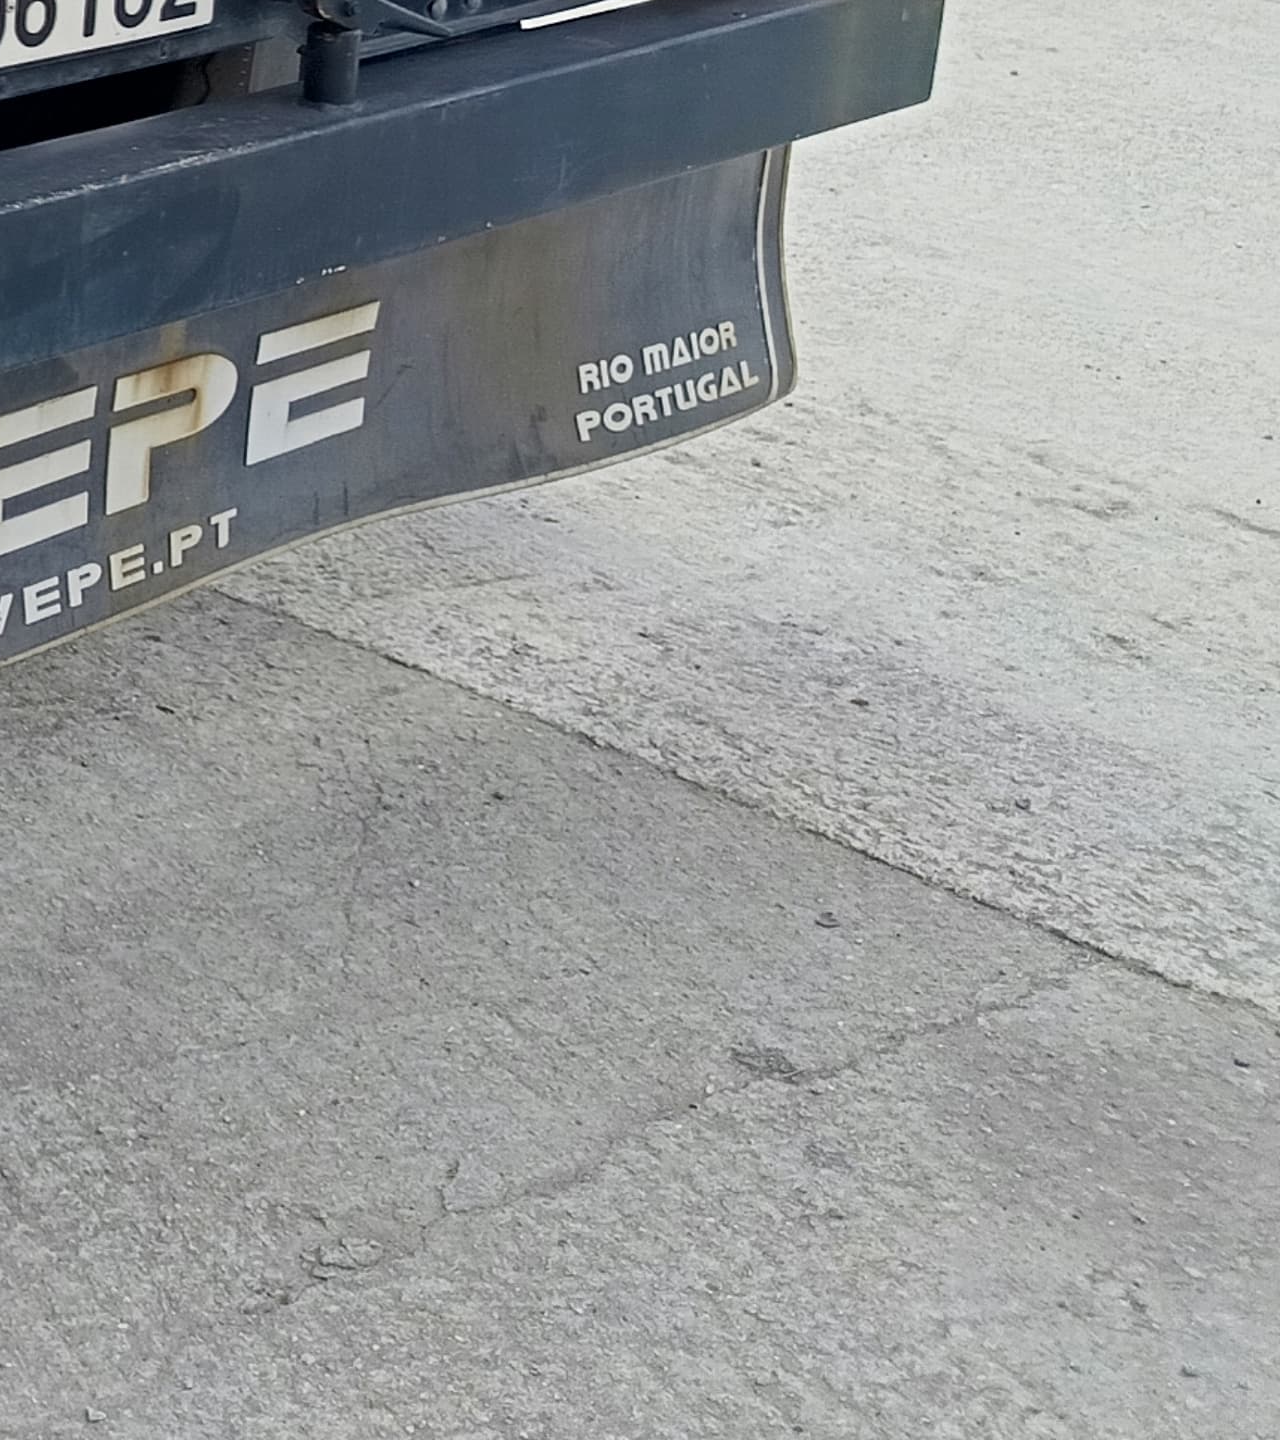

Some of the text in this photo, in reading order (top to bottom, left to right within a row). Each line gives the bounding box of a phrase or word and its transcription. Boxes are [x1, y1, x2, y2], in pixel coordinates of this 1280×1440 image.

[578, 320, 737, 394] RIO MAIOR
[576, 360, 760, 442] PORTUGAL
